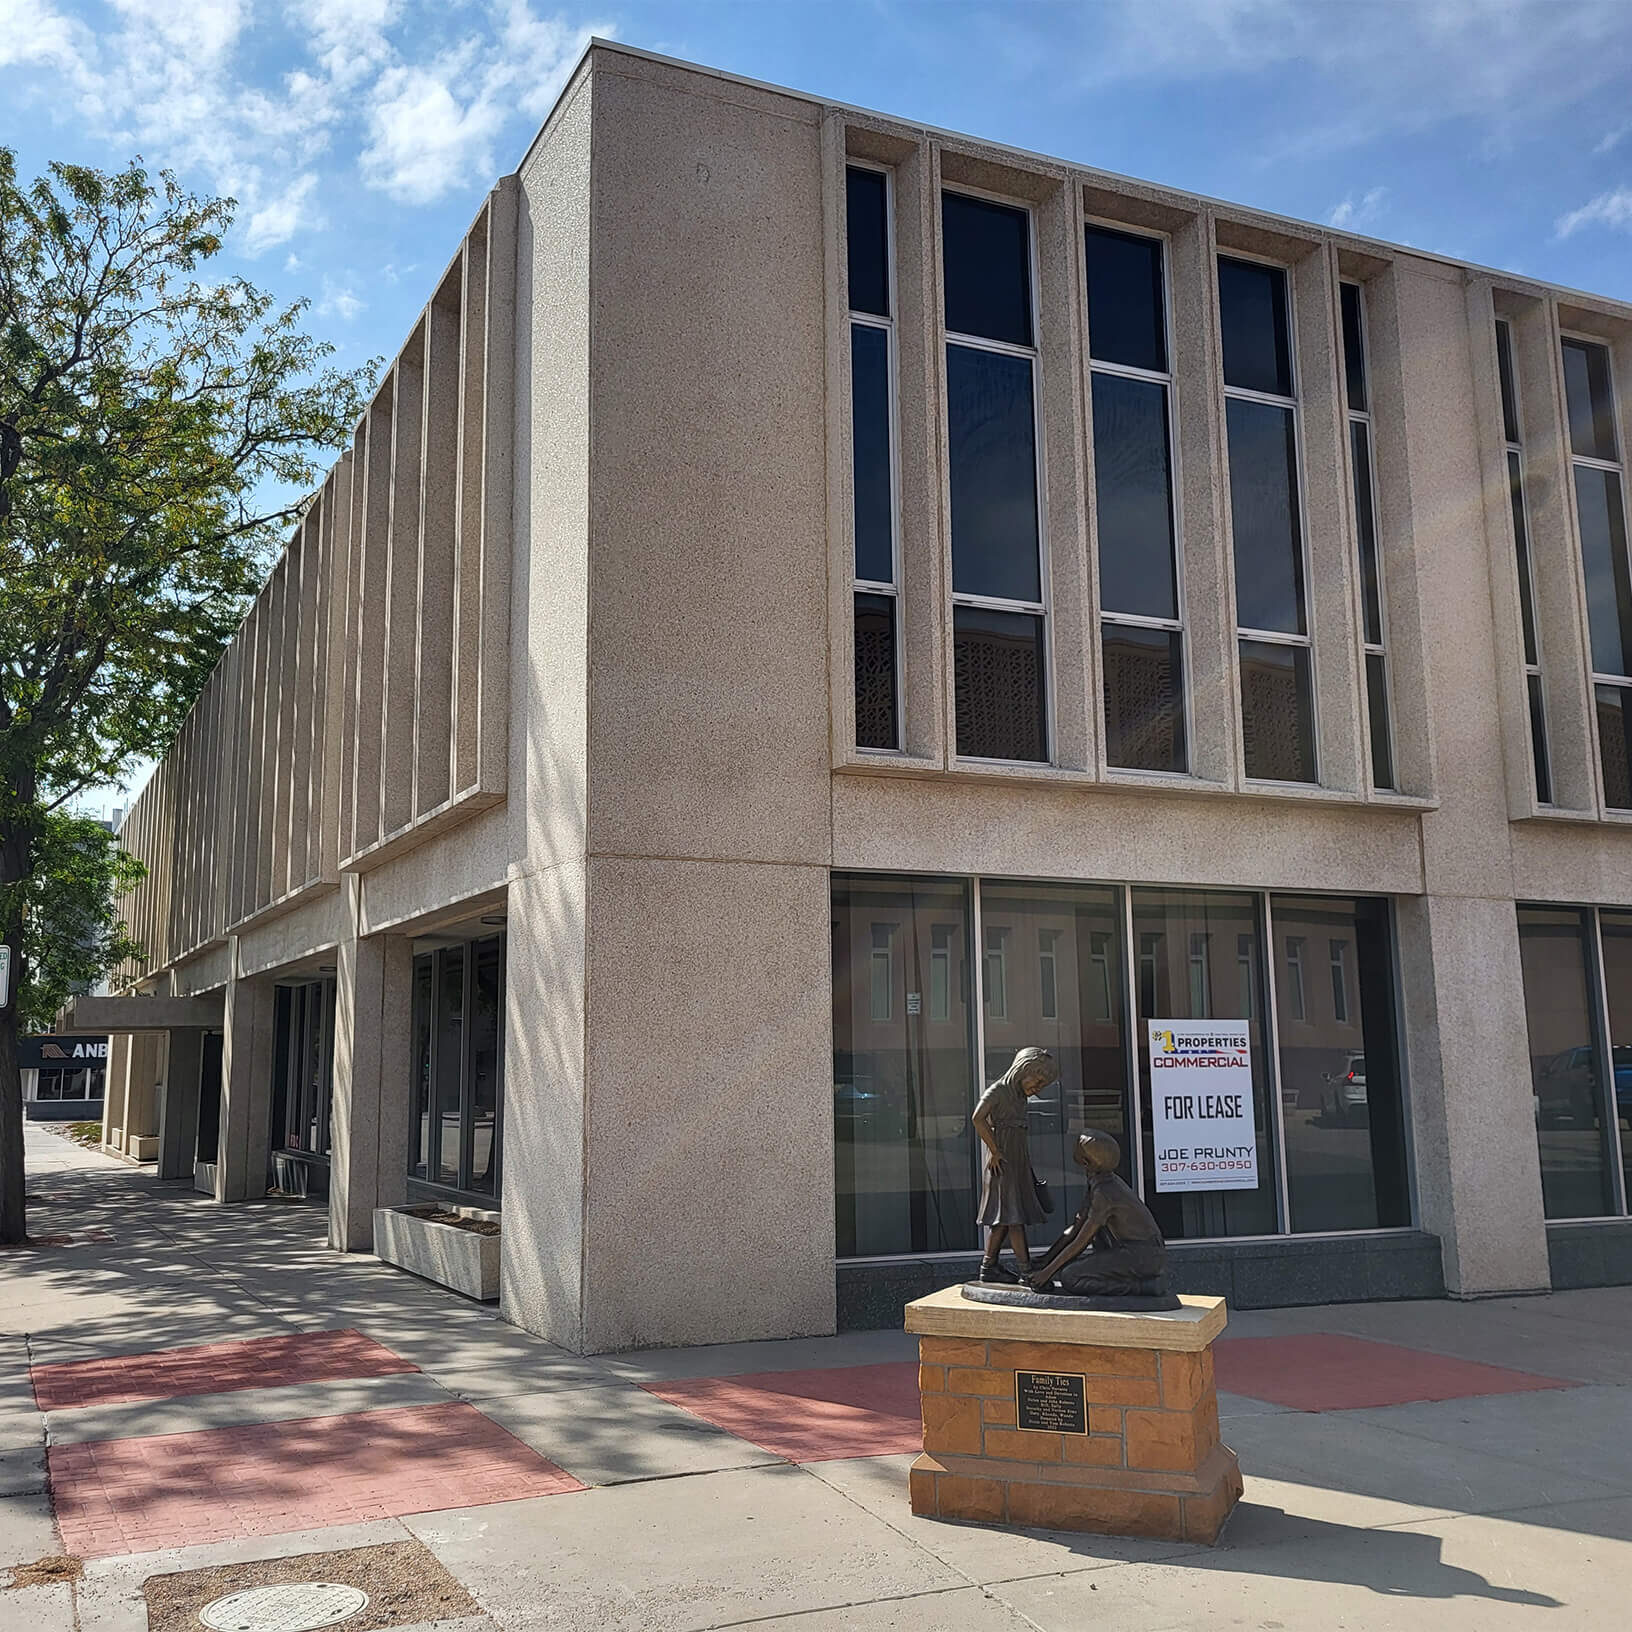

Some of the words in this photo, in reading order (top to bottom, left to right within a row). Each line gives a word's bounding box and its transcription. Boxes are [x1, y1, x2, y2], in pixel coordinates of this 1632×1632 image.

[1177, 1037, 1247, 1048] PROPERTIES
[72, 1044, 109, 1058] ANB
[1153, 1056, 1249, 1068] COMMERCIAL
[1164, 1096, 1194, 1120] FOR
[1198, 1095, 1243, 1119] LEASE
[1158, 1148, 1189, 1161] JOE
[1194, 1146, 1254, 1159] PRUNTY
[1161, 1160, 1252, 1172] 307-630-0950
[1031, 1375, 1053, 1387] Family
[1055, 1376, 1070, 1386] Ties
